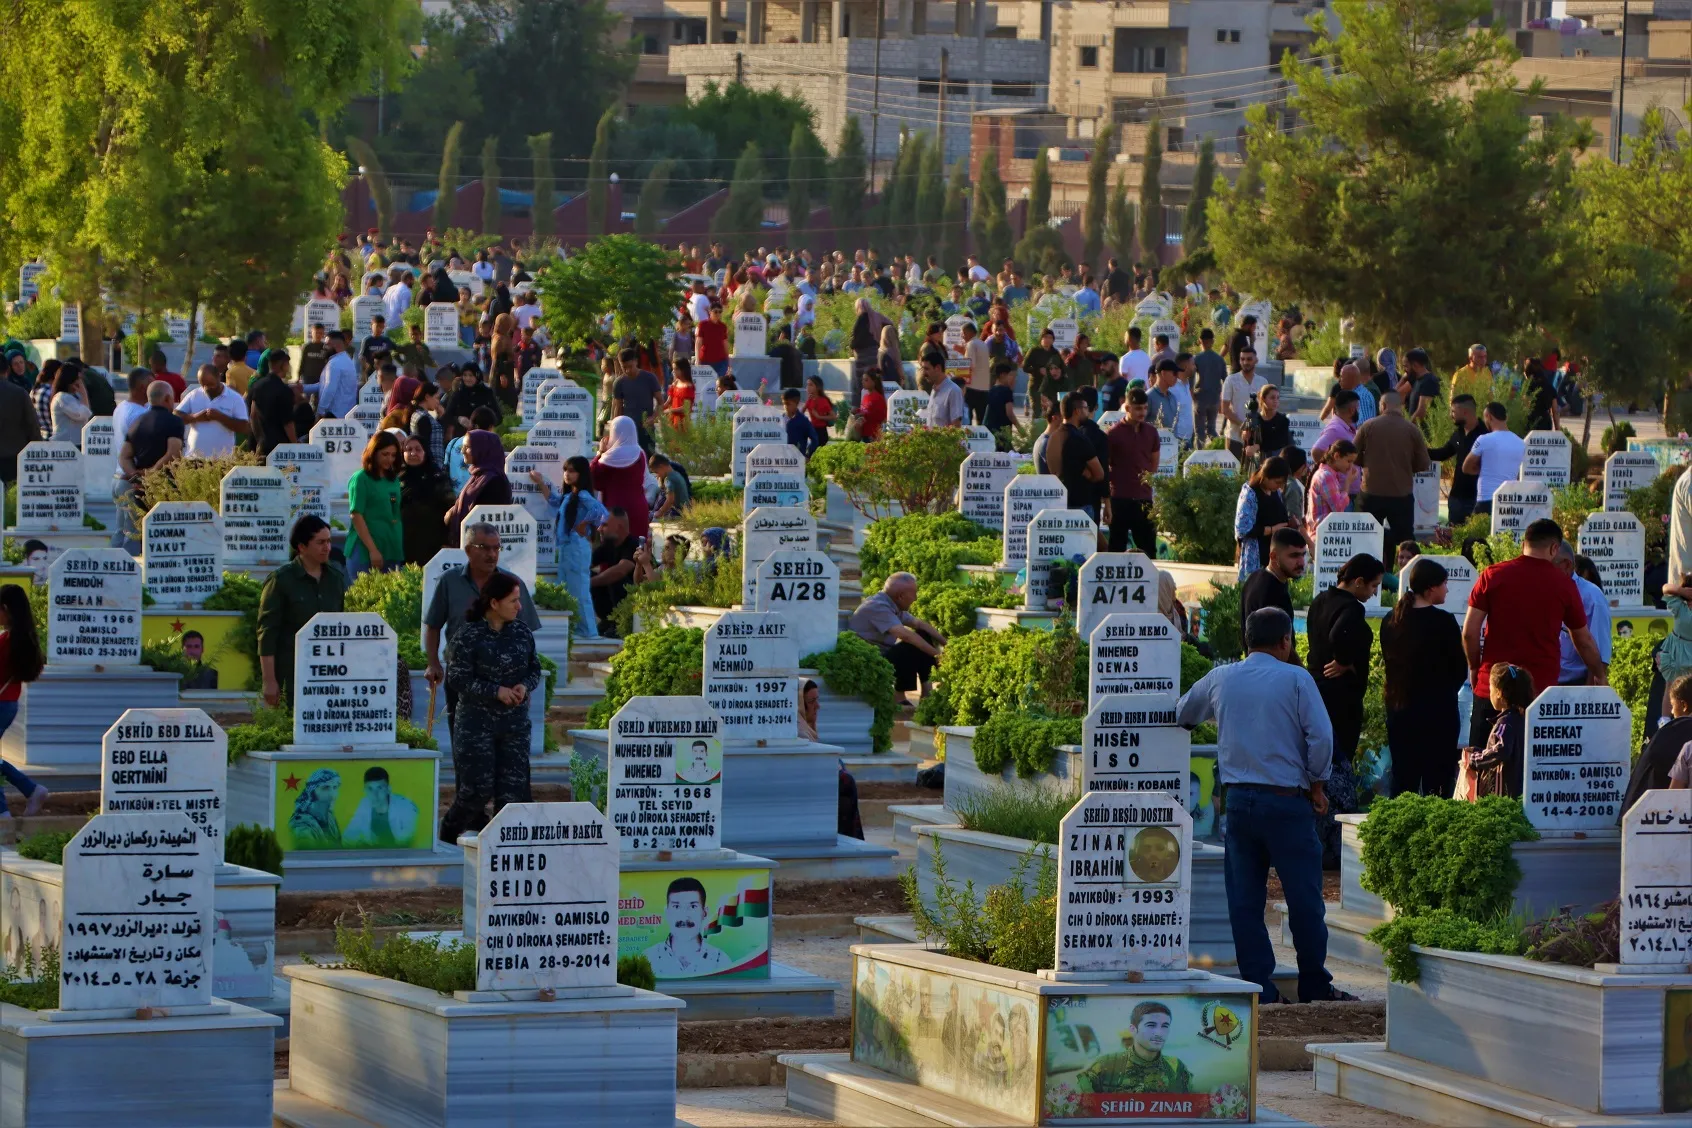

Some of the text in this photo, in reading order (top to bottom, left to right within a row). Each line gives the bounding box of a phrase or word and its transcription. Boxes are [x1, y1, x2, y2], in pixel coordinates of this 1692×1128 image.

[325, 441, 352, 453] B/3
[149, 529, 185, 538] LOKMAN
[1039, 535, 1065, 544] EHMED
[1324, 536, 1352, 545] ORHAN
[1582, 536, 1614, 545] CIWAN
[149, 542, 186, 552] YAKUT
[771, 582, 825, 600] A/28
[1092, 586, 1146, 604] A/14
[758, 624, 786, 635] AKIF
[1139, 626, 1168, 636] MEMO
[720, 644, 747, 655] XALID
[1098, 646, 1138, 658] MIHEMED
[310, 665, 347, 676] TEMO
[1097, 662, 1138, 673] QEWAS
[353, 686, 386, 694] 1990
[755, 682, 786, 692] 1997
[327, 699, 369, 708] QAMIŞLO
[1574, 703, 1621, 715] BEREKAT
[302, 711, 315, 720] CIH
[158, 726, 180, 738] EBD
[185, 726, 214, 738] ELLA
[355, 723, 392, 732] 25-3-2014
[1533, 726, 1583, 739] BEREKAT
[615, 744, 652, 758] MUHEMED
[1532, 744, 1582, 757] MIHEMED
[112, 750, 168, 764] EBD ELLA
[625, 764, 661, 778] MUHEMED
[1580, 767, 1622, 779] QAMIŞLO
[1138, 778, 1180, 789] KOBANÊ
[1587, 781, 1614, 789] 1946
[674, 788, 711, 798] 1968
[1532, 793, 1544, 803] CIH
[162, 799, 181, 810] TEL
[639, 800, 692, 810] TEL SEYID
[1542, 805, 1613, 816] 14-4-2008
[614, 813, 628, 823] CIH
[1141, 808, 1173, 822] DOSTIM
[652, 826, 676, 836] CADA
[1071, 835, 1124, 851] ZINAR
[491, 854, 546, 871] EHMED
[142, 863, 194, 881] سارة
[490, 879, 546, 897] SEIDO
[138, 889, 191, 906] جبار
[1132, 890, 1174, 903] 1993
[555, 911, 609, 926] QAMIŞLO
[1068, 913, 1083, 926] CIH
[487, 934, 503, 949] CIH
[1064, 934, 1182, 948] SERMOX 16-9-2014
[540, 953, 610, 969] 28-9-2014
[1101, 1099, 1193, 1115] ŞEHÎD ZINAR
